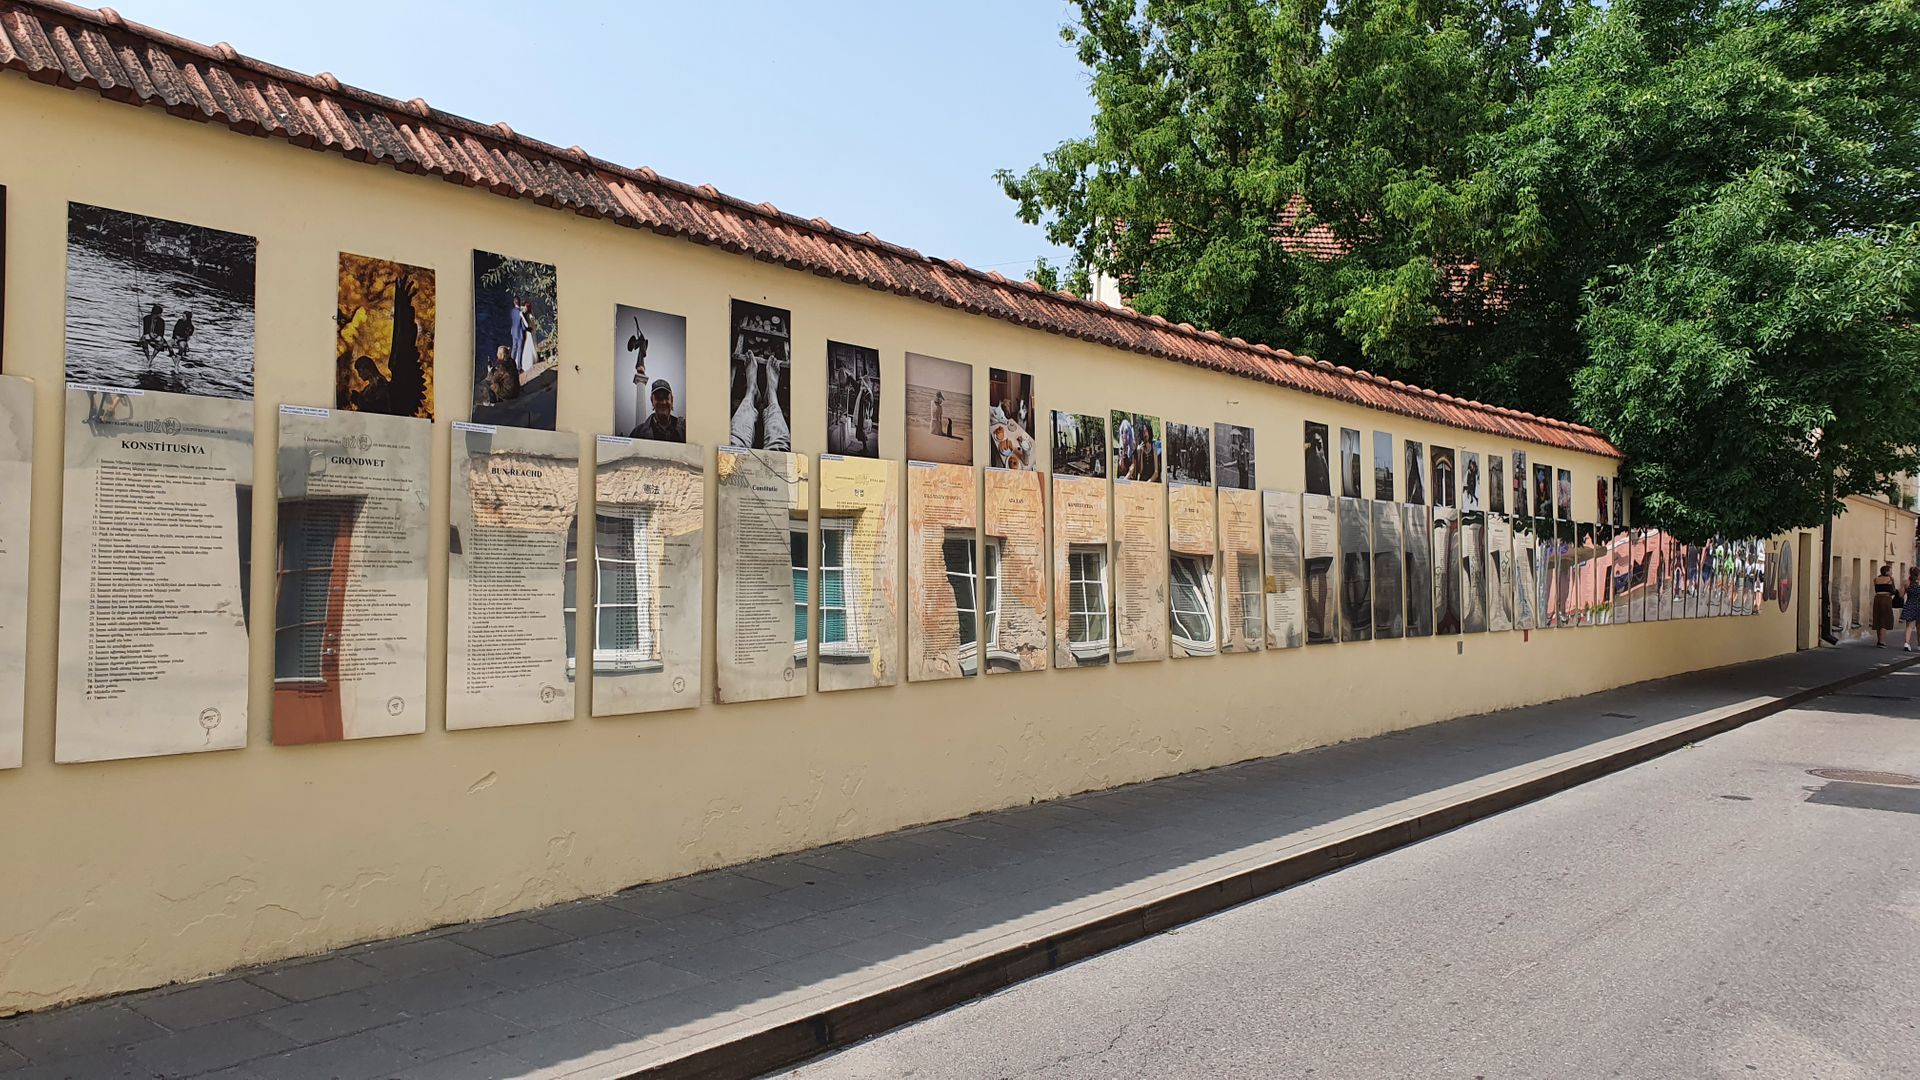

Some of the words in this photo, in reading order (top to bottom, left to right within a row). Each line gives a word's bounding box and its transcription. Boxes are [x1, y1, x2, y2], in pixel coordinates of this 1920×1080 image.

[121, 440, 206, 455] KONSTİTUSİYA
[331, 456, 385, 468] GRONDWET
[491, 467, 543, 478] BUN-REACHD
